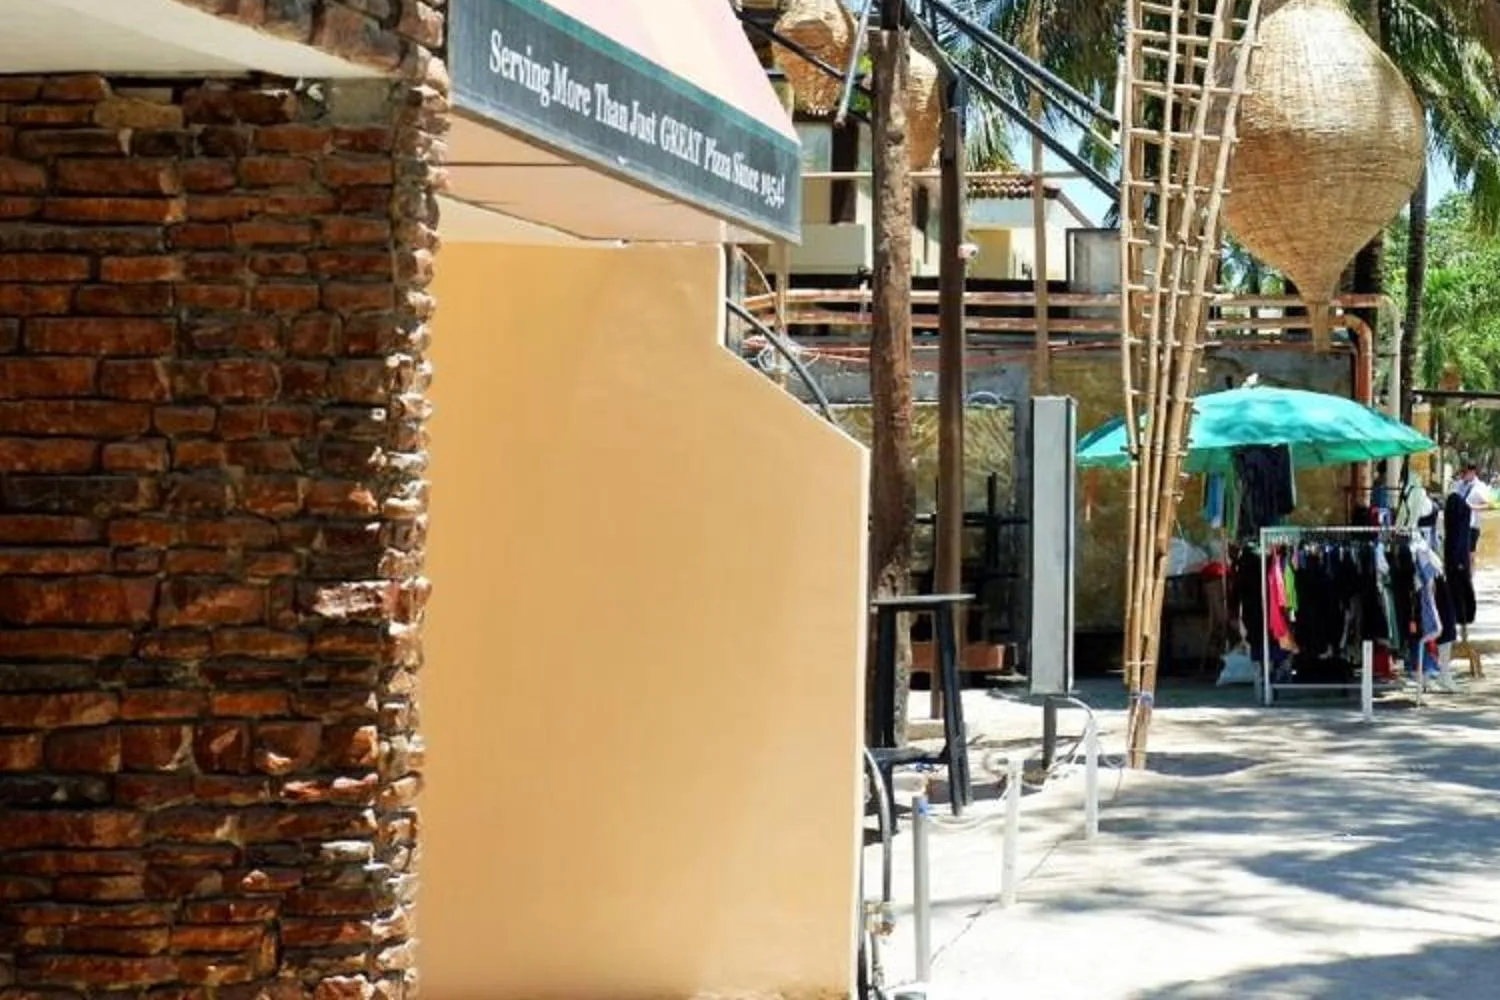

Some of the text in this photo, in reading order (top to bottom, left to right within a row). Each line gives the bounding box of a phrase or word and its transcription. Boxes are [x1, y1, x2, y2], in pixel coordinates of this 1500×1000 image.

[489, 29, 550, 108] Serving
[552, 60, 592, 117] More
[594, 82, 629, 133] Than
[629, 100, 657, 145] Just
[659, 114, 703, 167] GREAT
[703, 136, 731, 181] Pizza
[731, 151, 759, 194] Since
